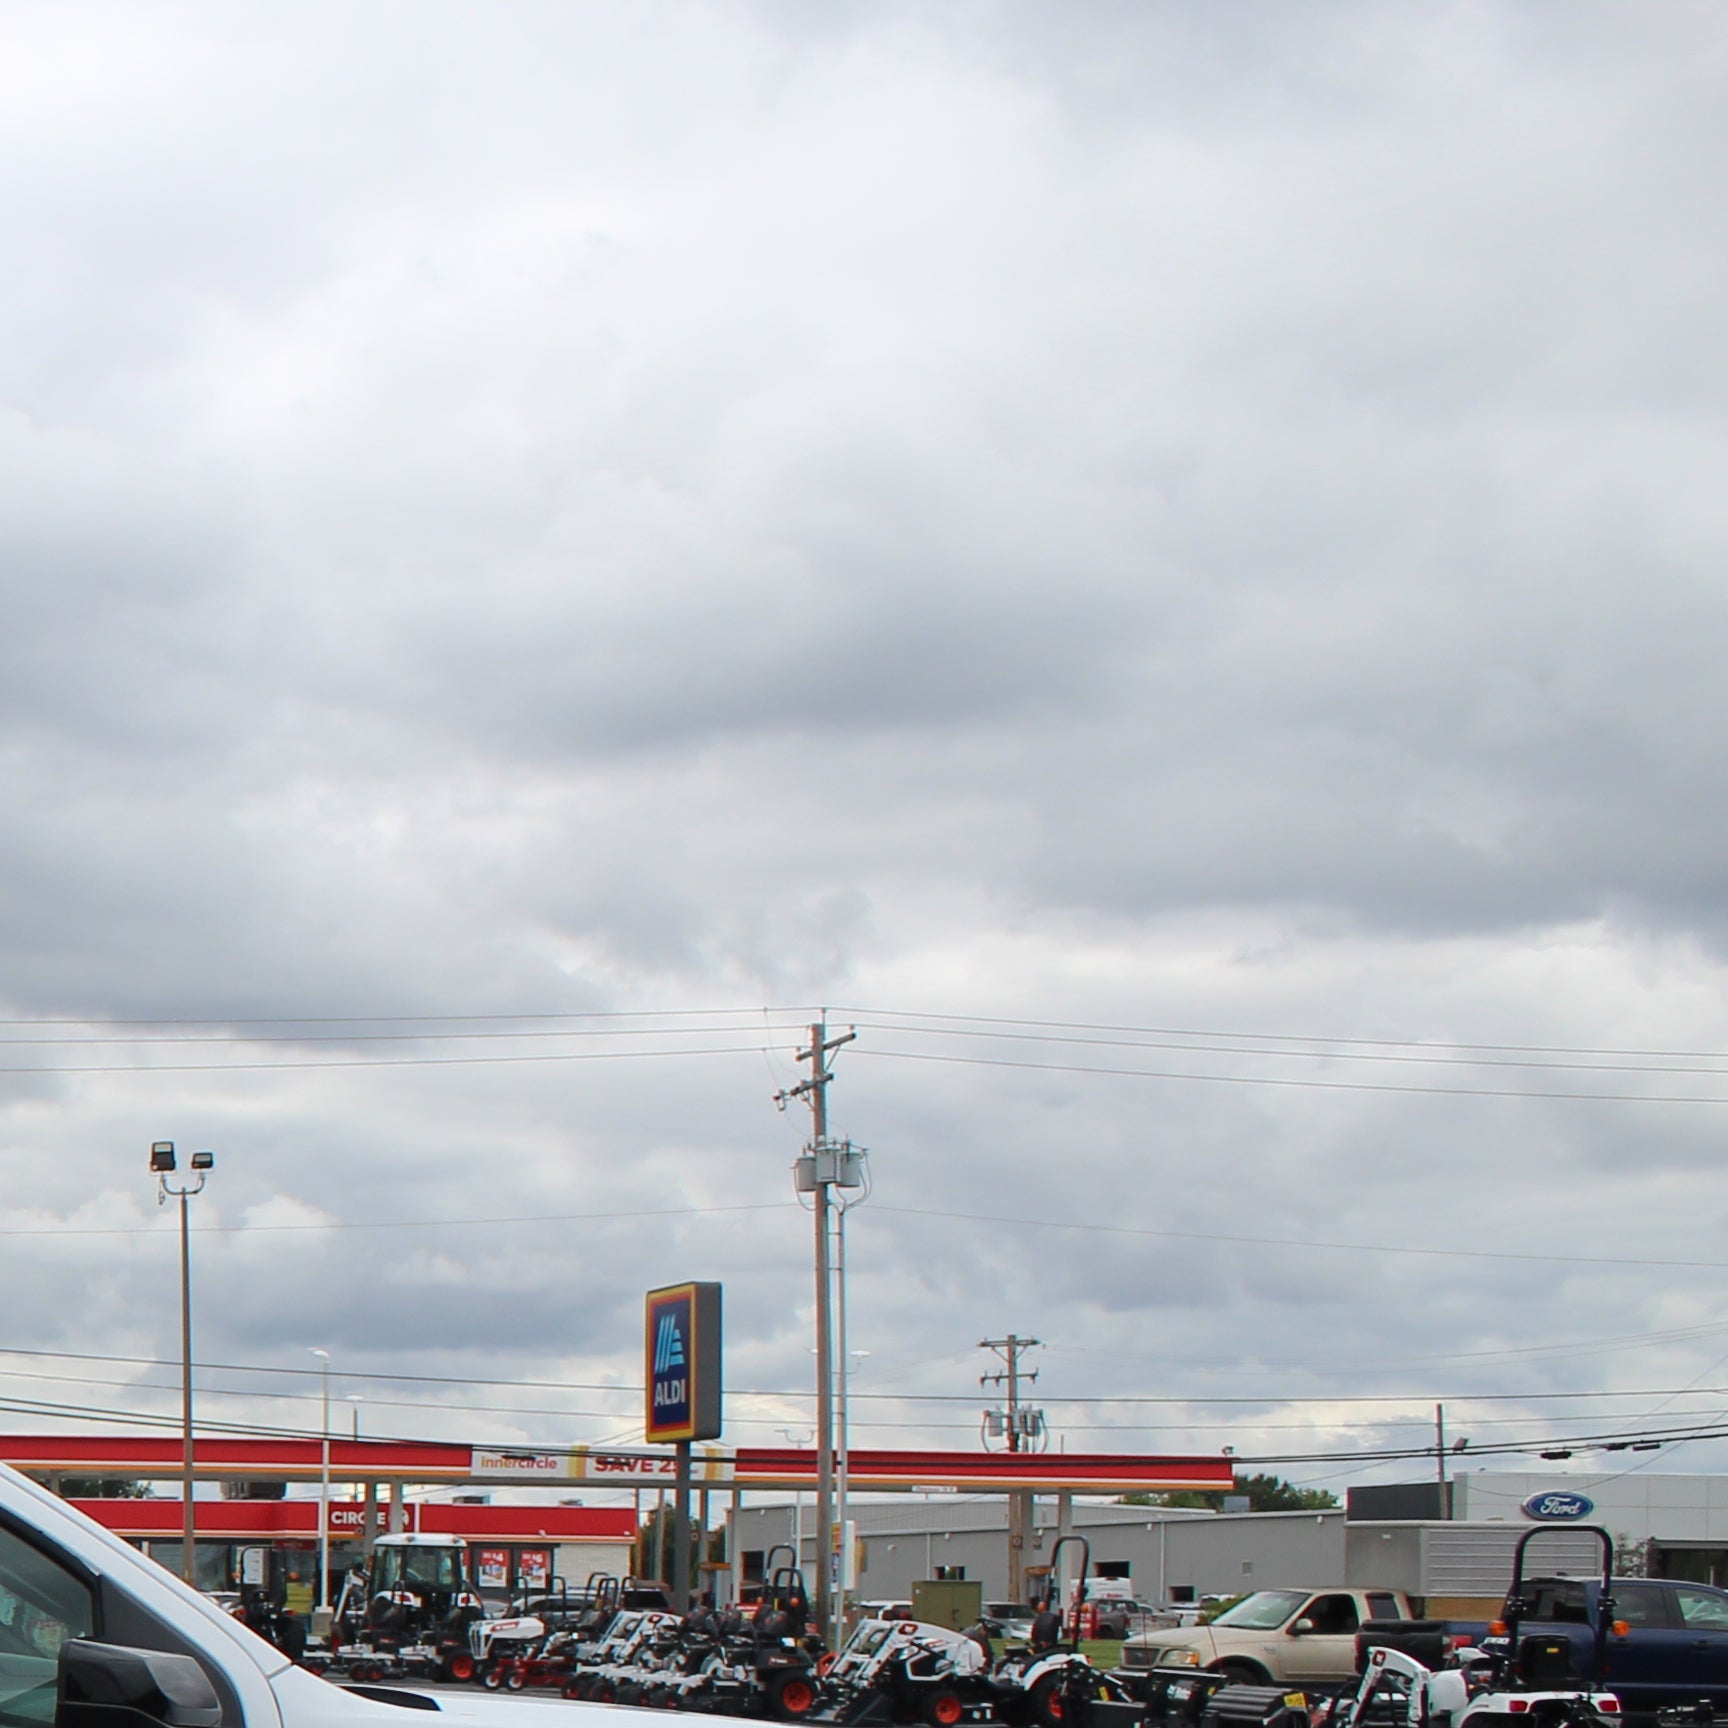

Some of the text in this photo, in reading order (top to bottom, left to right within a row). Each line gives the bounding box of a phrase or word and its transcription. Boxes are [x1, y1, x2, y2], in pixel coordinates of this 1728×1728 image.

[654, 1379, 686, 1407] ALDI
[481, 1456, 557, 1469] innercircle
[594, 1457, 654, 1473] SAVE
[1540, 1496, 1581, 1514] Ford
[331, 1510, 386, 1525] CIRCE
